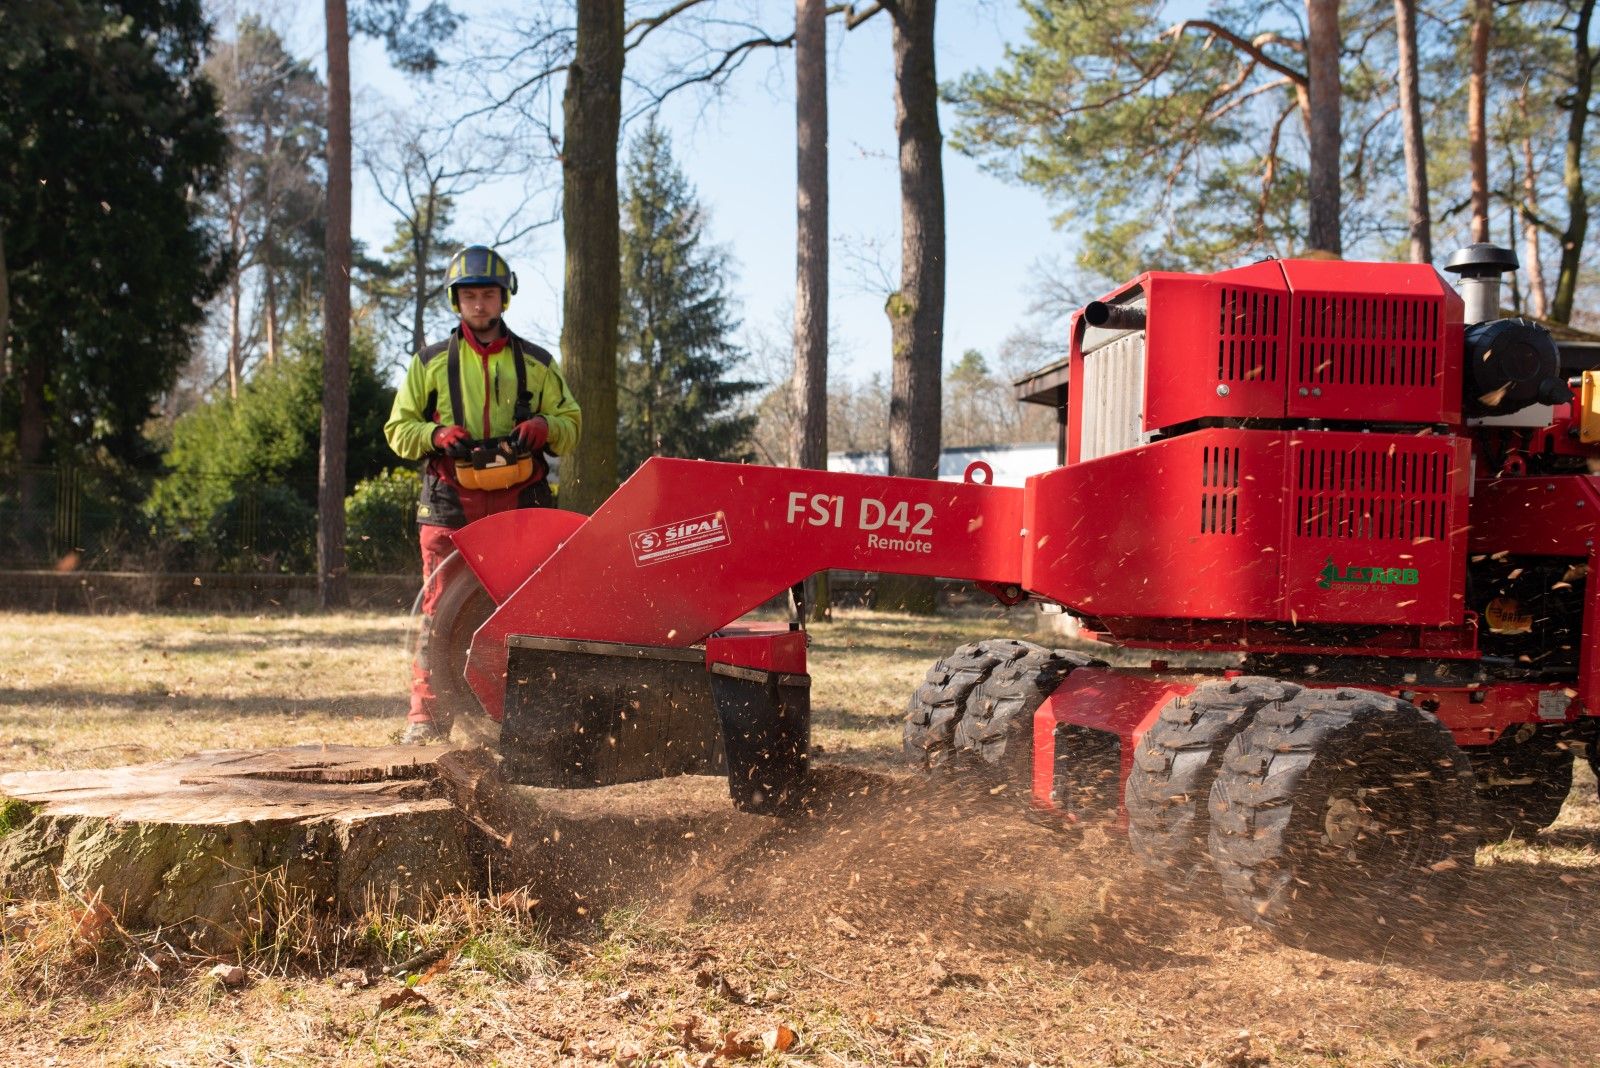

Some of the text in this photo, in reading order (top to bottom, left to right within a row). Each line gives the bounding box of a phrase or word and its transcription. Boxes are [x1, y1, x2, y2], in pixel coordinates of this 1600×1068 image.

[859, 497, 933, 536] D42
[664, 518, 723, 541] ŠÍPAL
[868, 533, 932, 553] Remote
